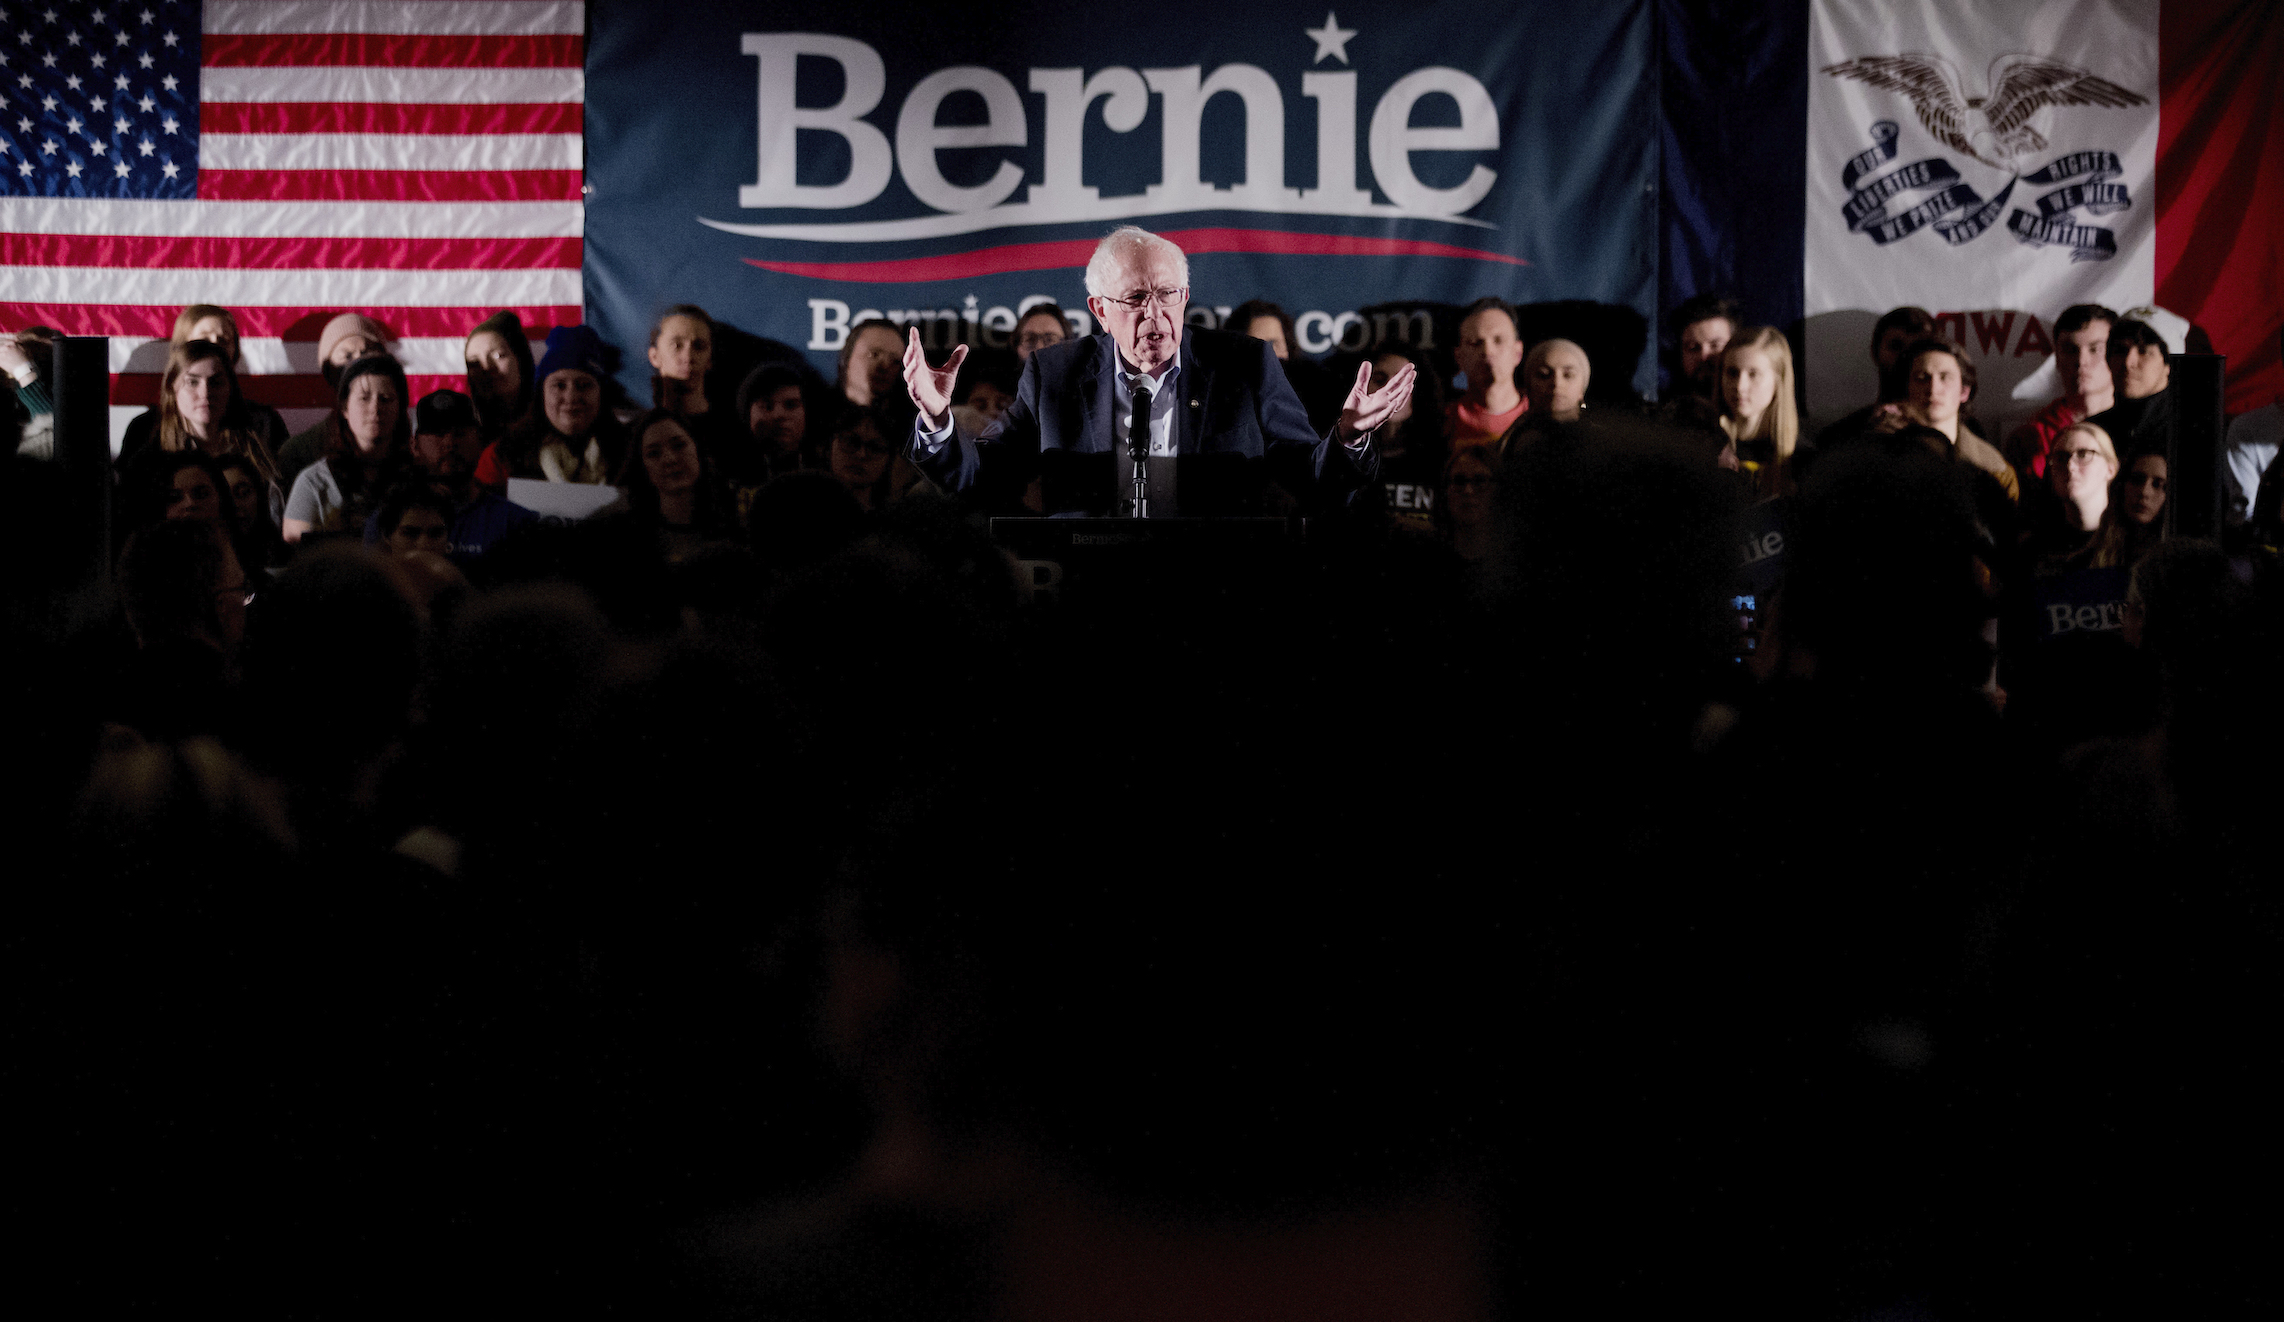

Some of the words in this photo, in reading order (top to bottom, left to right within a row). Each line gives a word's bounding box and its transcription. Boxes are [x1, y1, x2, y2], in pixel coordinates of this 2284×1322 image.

[740, 12, 1500, 213] Bernie
[2048, 152, 2112, 181] RIGHTS
[1850, 160, 1931, 220] LIBERTIES
[2047, 187, 2074, 213] WE
[2080, 183, 2120, 204] WILL
[1880, 216, 1908, 242] WE
[1908, 189, 1959, 228] PRIZE
[2020, 212, 2099, 247] MAINTAIN
[1936, 311, 2053, 358] OWA
[2046, 602, 2124, 635] Ber
